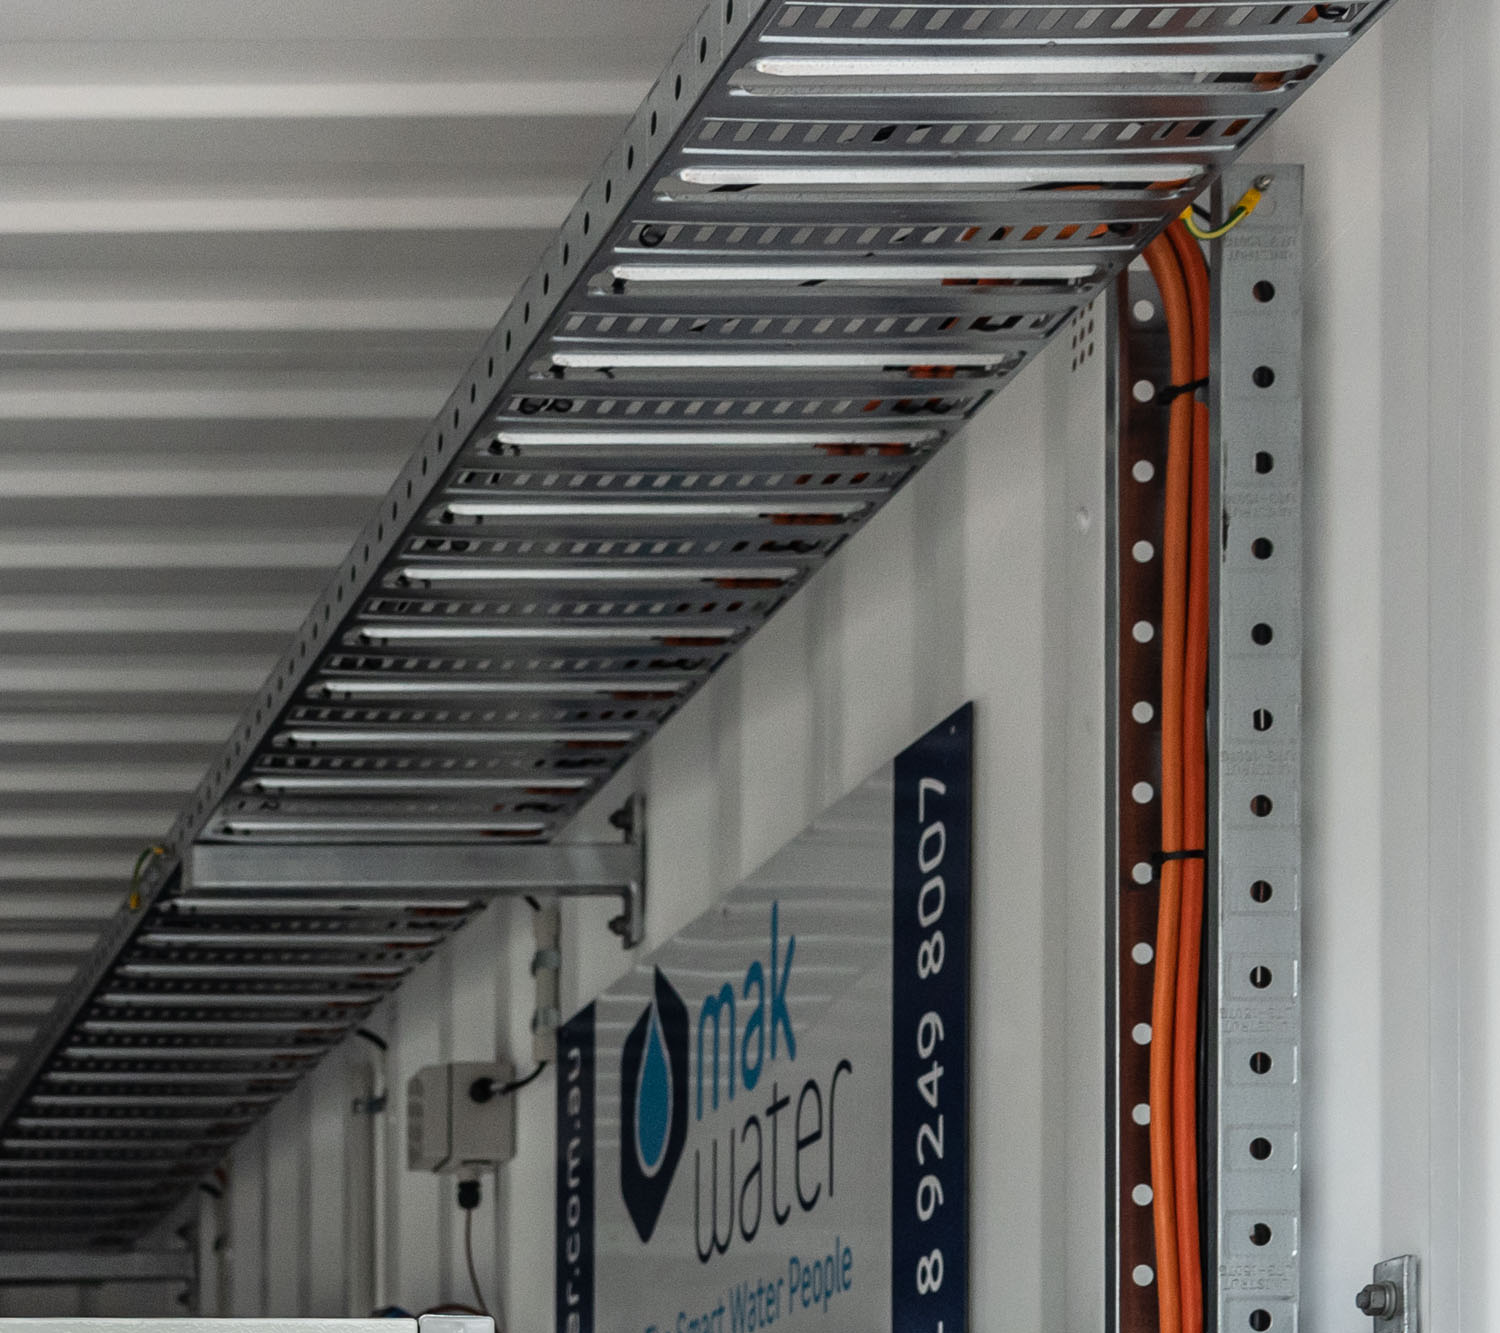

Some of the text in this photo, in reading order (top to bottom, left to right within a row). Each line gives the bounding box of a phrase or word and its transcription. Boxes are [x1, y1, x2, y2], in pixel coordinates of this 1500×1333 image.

[916, 776, 947, 980] 8007
[697, 900, 796, 1122] mak
[694, 1058, 852, 1264] water
[916, 1010, 946, 1223] 9249
[788, 1235, 853, 1314] People
